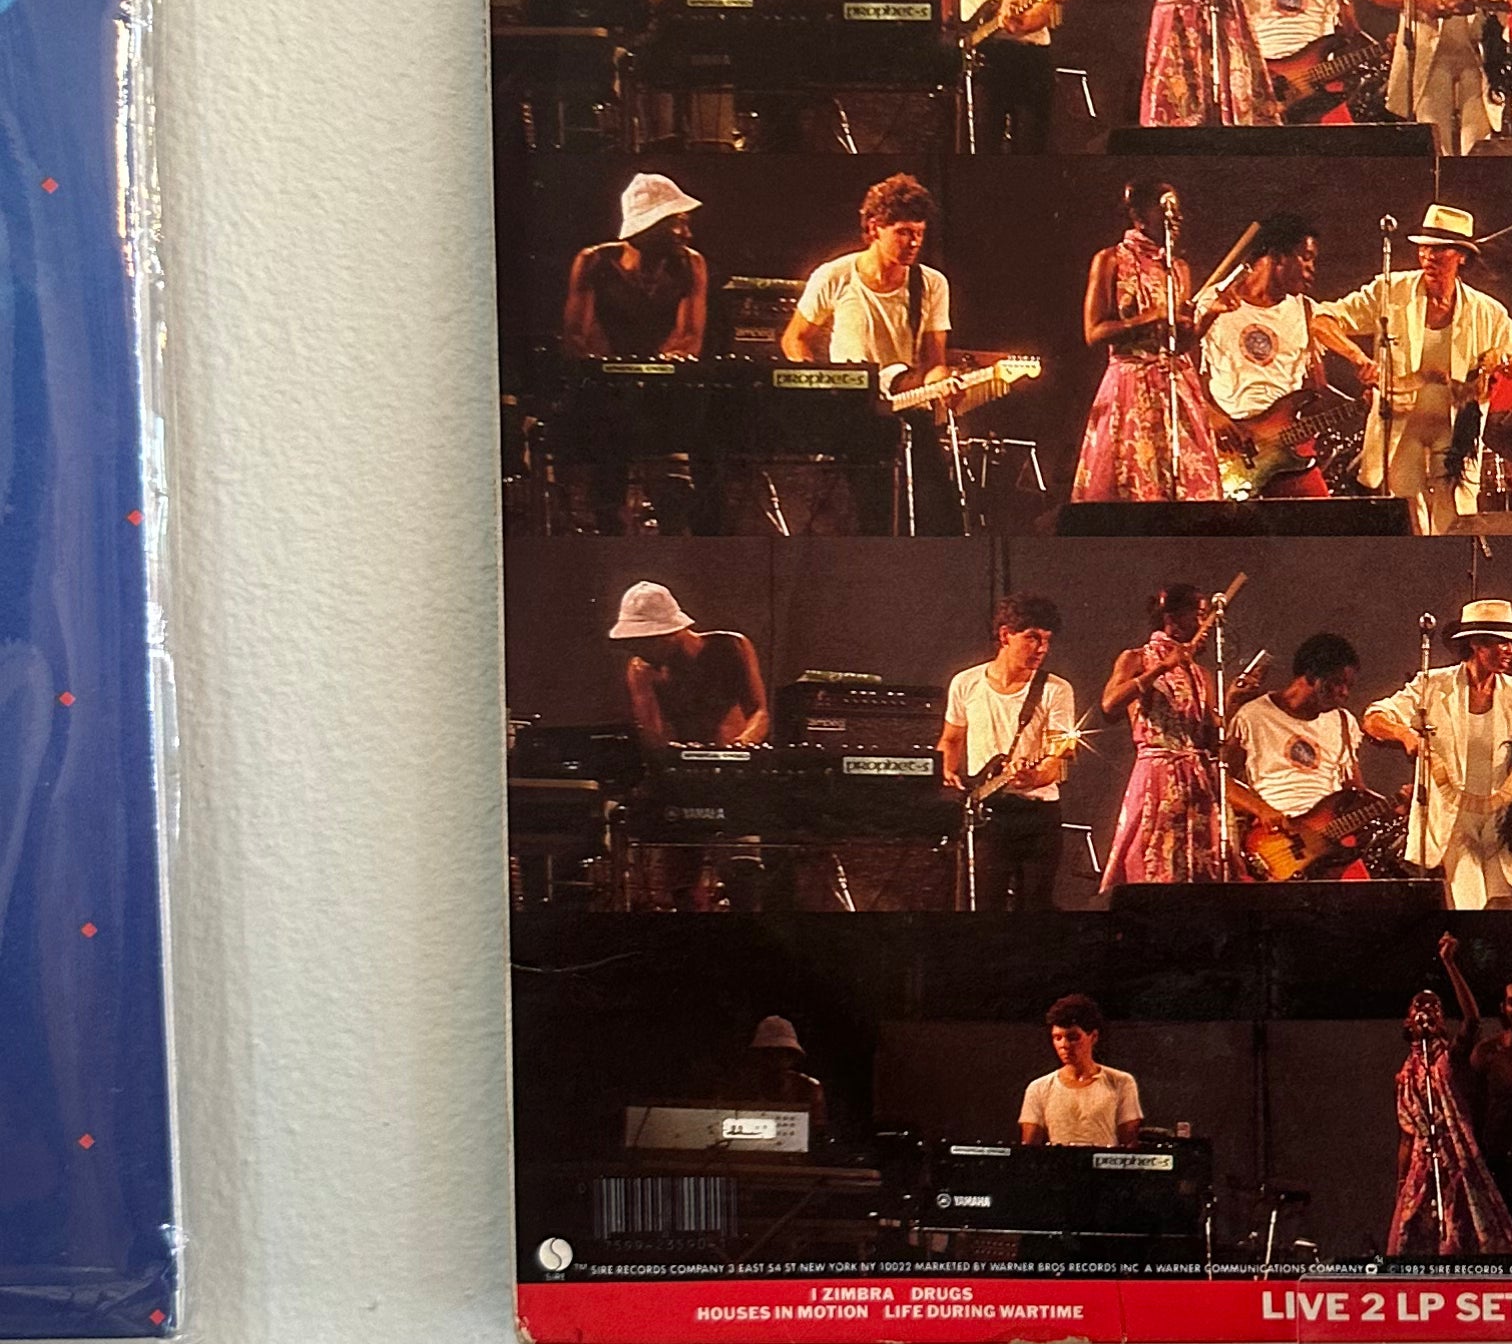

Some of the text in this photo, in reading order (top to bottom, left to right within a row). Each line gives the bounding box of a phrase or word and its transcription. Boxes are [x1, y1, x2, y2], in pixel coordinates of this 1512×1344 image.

[590, 1265, 613, 1275] SIRE
[616, 1264, 667, 1275] RECORDS
[669, 1264, 724, 1275] COMPANY
[738, 1263, 765, 1274] EAST
[784, 1263, 798, 1273] ST
[800, 1262, 825, 1273] NEW
[829, 1262, 857, 1272] YORK
[861, 1262, 875, 1272] NY
[880, 1261, 912, 1272] 10022
[914, 1261, 970, 1272] MARKETED
[973, 1261, 987, 1272] BY
[990, 1262, 1035, 1273] WARNER
[1038, 1262, 1065, 1273] BROS
[1068, 1263, 1117, 1273] RECORDS
[1120, 1264, 1140, 1274] INC
[1144, 1264, 1153, 1274] A
[1156, 1264, 1201, 1274] WARNER
[1204, 1264, 1306, 1275] COMMUNICATIONS
[1309, 1264, 1363, 1275] COMPANY
[1429, 1264, 1451, 1275] SIRE
[1454, 1264, 1504, 1275] RECORDS
[811, 1286, 974, 1302] I ZIMBRA DRUGS
[696, 1304, 1084, 1321] HOUSES IN MOTION LIFE DURING WARTIME
[1261, 1290, 1351, 1322] LIVE
[1360, 1292, 1386, 1322] 2
[1397, 1291, 1446, 1322] LP
